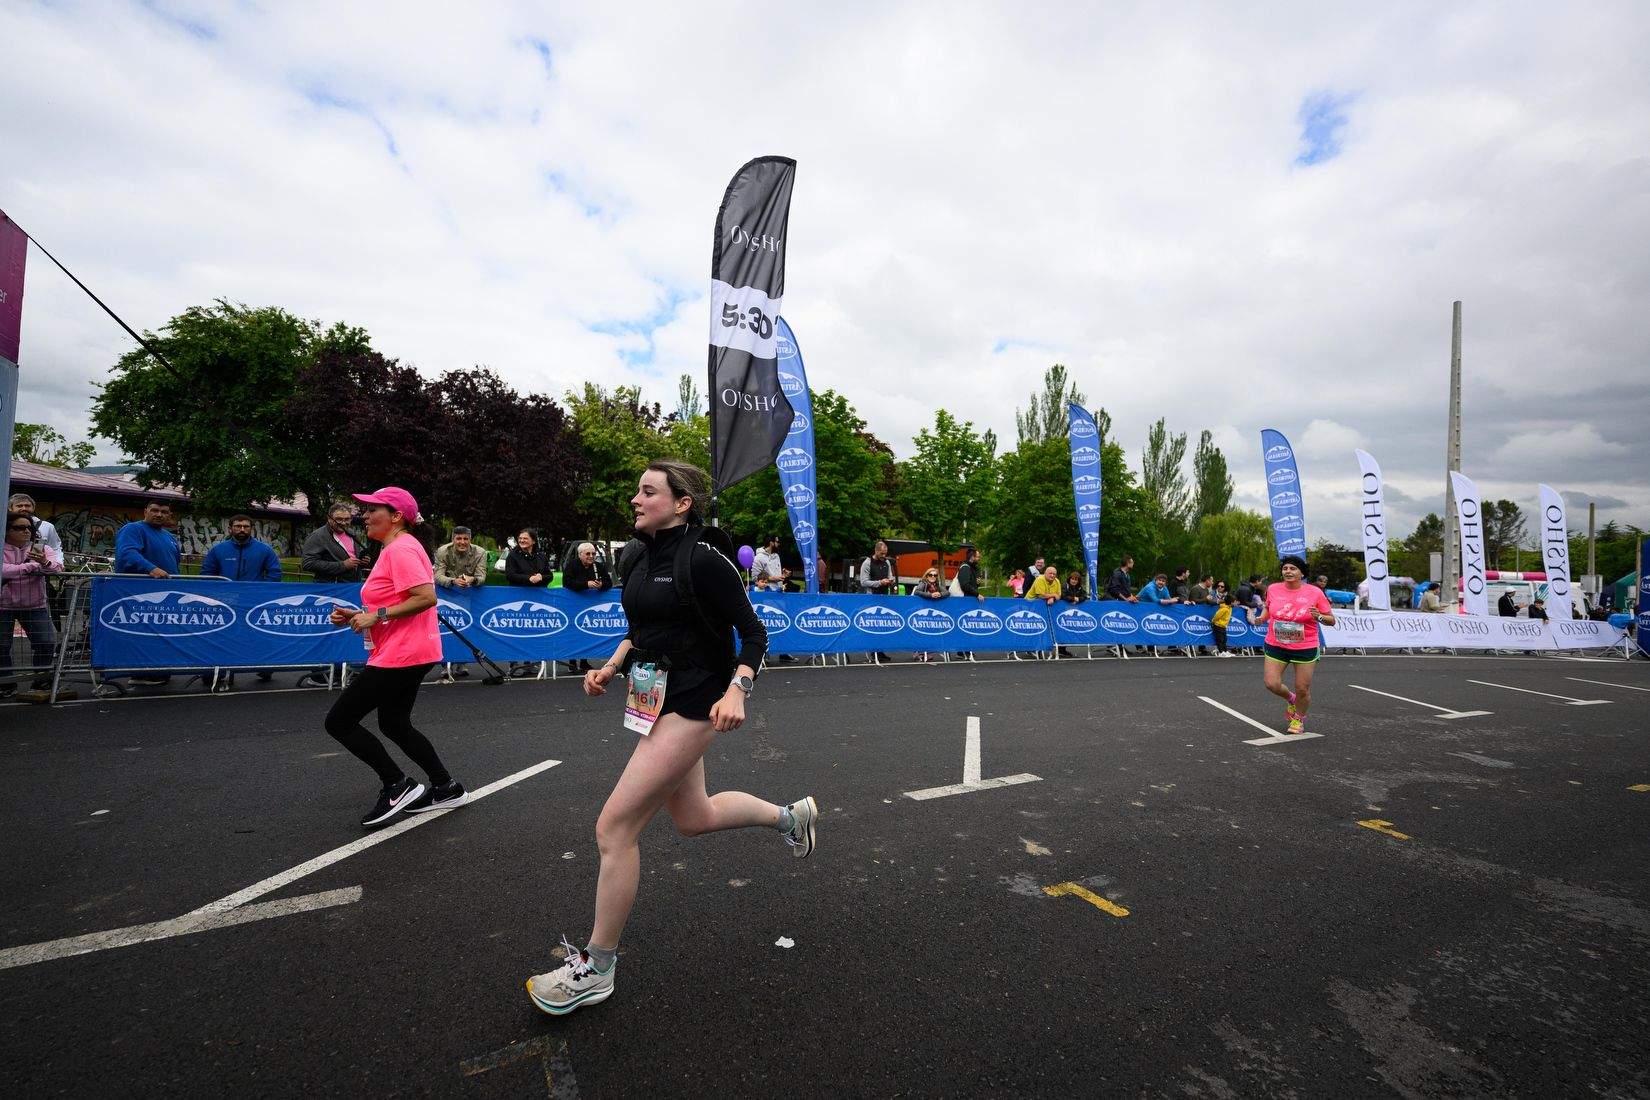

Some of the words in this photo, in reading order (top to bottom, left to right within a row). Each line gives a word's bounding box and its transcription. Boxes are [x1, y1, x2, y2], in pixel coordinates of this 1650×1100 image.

[108, 605, 226, 626] ASTURIANA
[486, 613, 563, 629] ASTURIANA
[800, 616, 848, 628] ASTURIANA
[858, 616, 901, 628] ASTURIANA
[912, 617, 951, 629] ASTURIANA
[961, 618, 1000, 629] ASTURIANA
[1390, 617, 1432, 633] OYSHO
[1449, 620, 1490, 635] OYSHO
[1502, 622, 1542, 637] OYSHO
[1560, 621, 1599, 636] OYSHO
